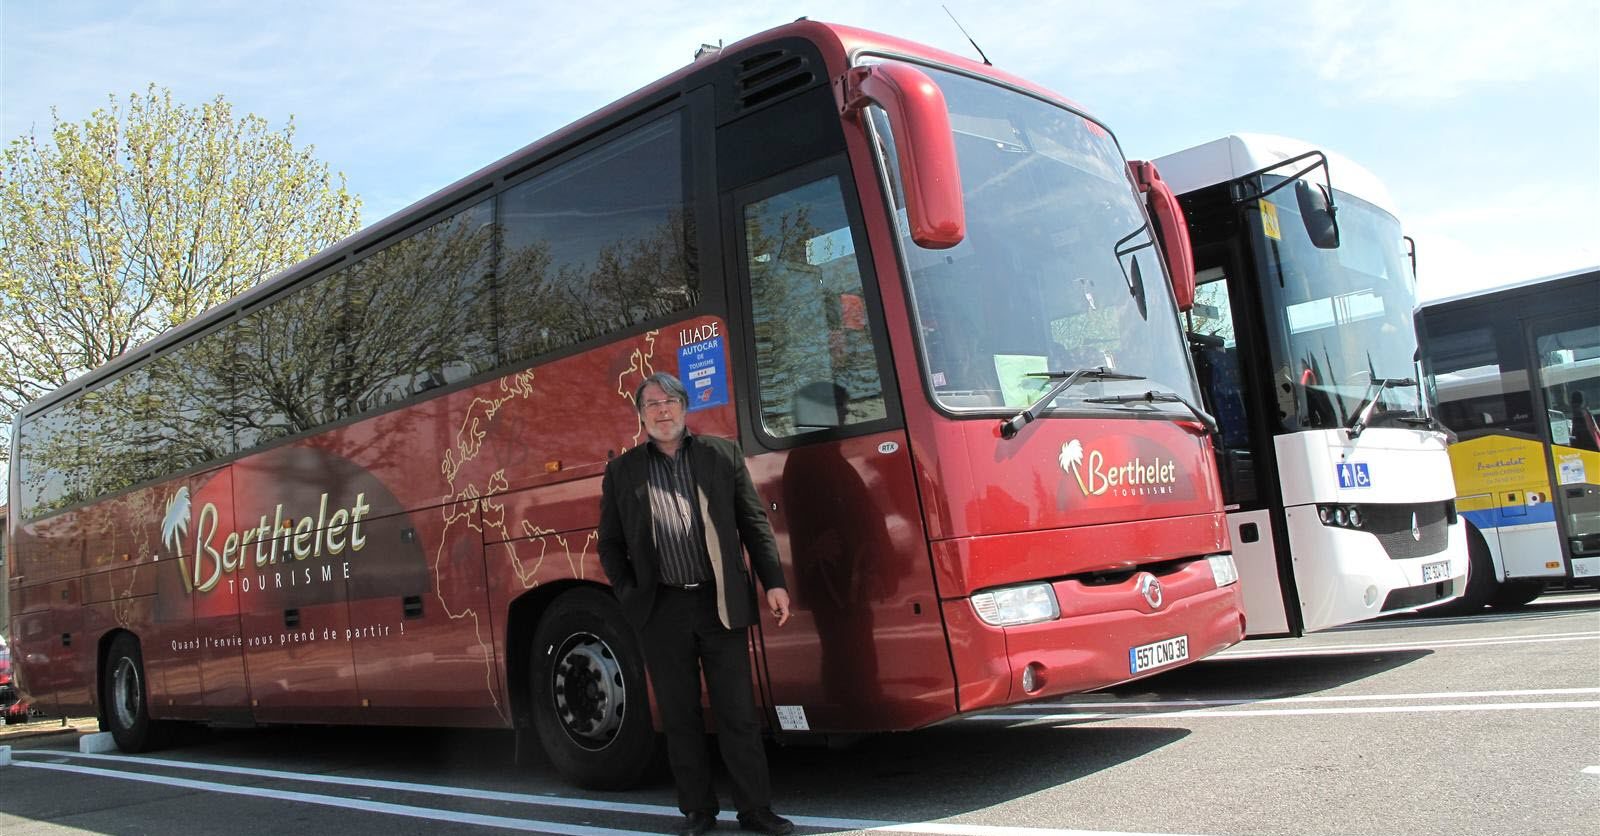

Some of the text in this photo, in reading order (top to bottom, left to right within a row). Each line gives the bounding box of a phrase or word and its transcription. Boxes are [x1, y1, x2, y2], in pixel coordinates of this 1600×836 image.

[680, 322, 719, 346] ILIADE
[682, 340, 718, 356] AUTOCAR
[689, 359, 714, 370] TOURISME
[1088, 449, 1176, 496] Berthelet
[1113, 486, 1173, 497] TOURISME
[193, 492, 370, 593] Berthelet
[228, 562, 350, 595] TOURISME
[171, 638, 200, 651] Quand
[205, 636, 243, 648] l'envie
[248, 634, 273, 647] vous
[280, 627, 315, 645] prend
[323, 627, 337, 640] de
[346, 623, 390, 640] partir
[1137, 639, 1186, 669] 557 CNQ 38
